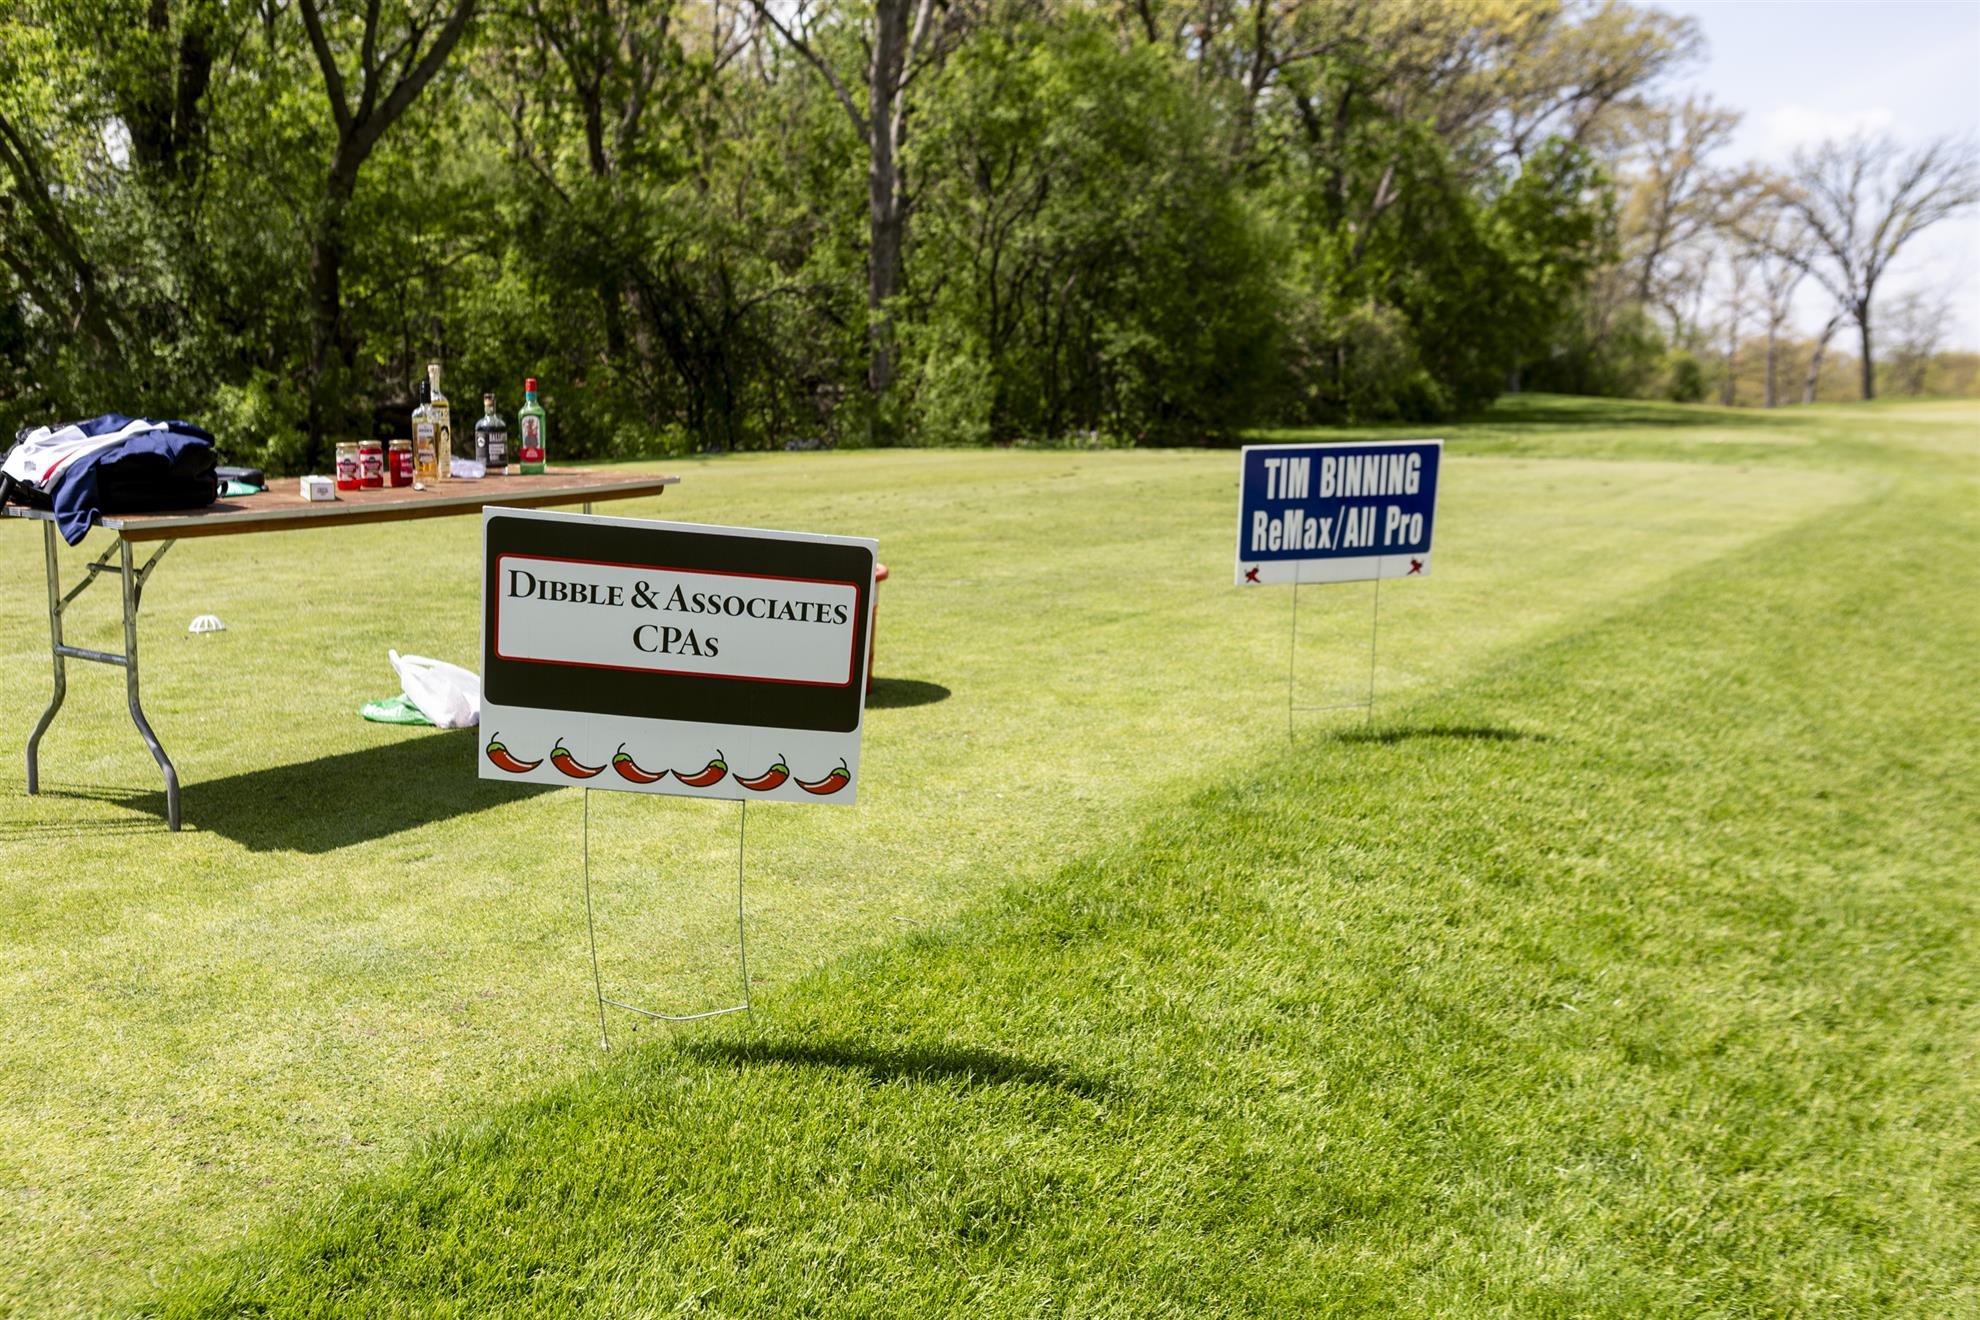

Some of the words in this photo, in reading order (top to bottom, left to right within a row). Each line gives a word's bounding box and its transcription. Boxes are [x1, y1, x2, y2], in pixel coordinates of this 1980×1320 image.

[1264, 457, 1311, 500] TIM
[1319, 452, 1422, 498] BINNING
[1251, 505, 1377, 552] ReMax/All
[1383, 505, 1424, 546] Pro
[507, 569, 625, 607] DIBBLE
[630, 580, 660, 610] &
[663, 583, 848, 625] ASSOCIATES
[632, 624, 719, 658] CPAs
